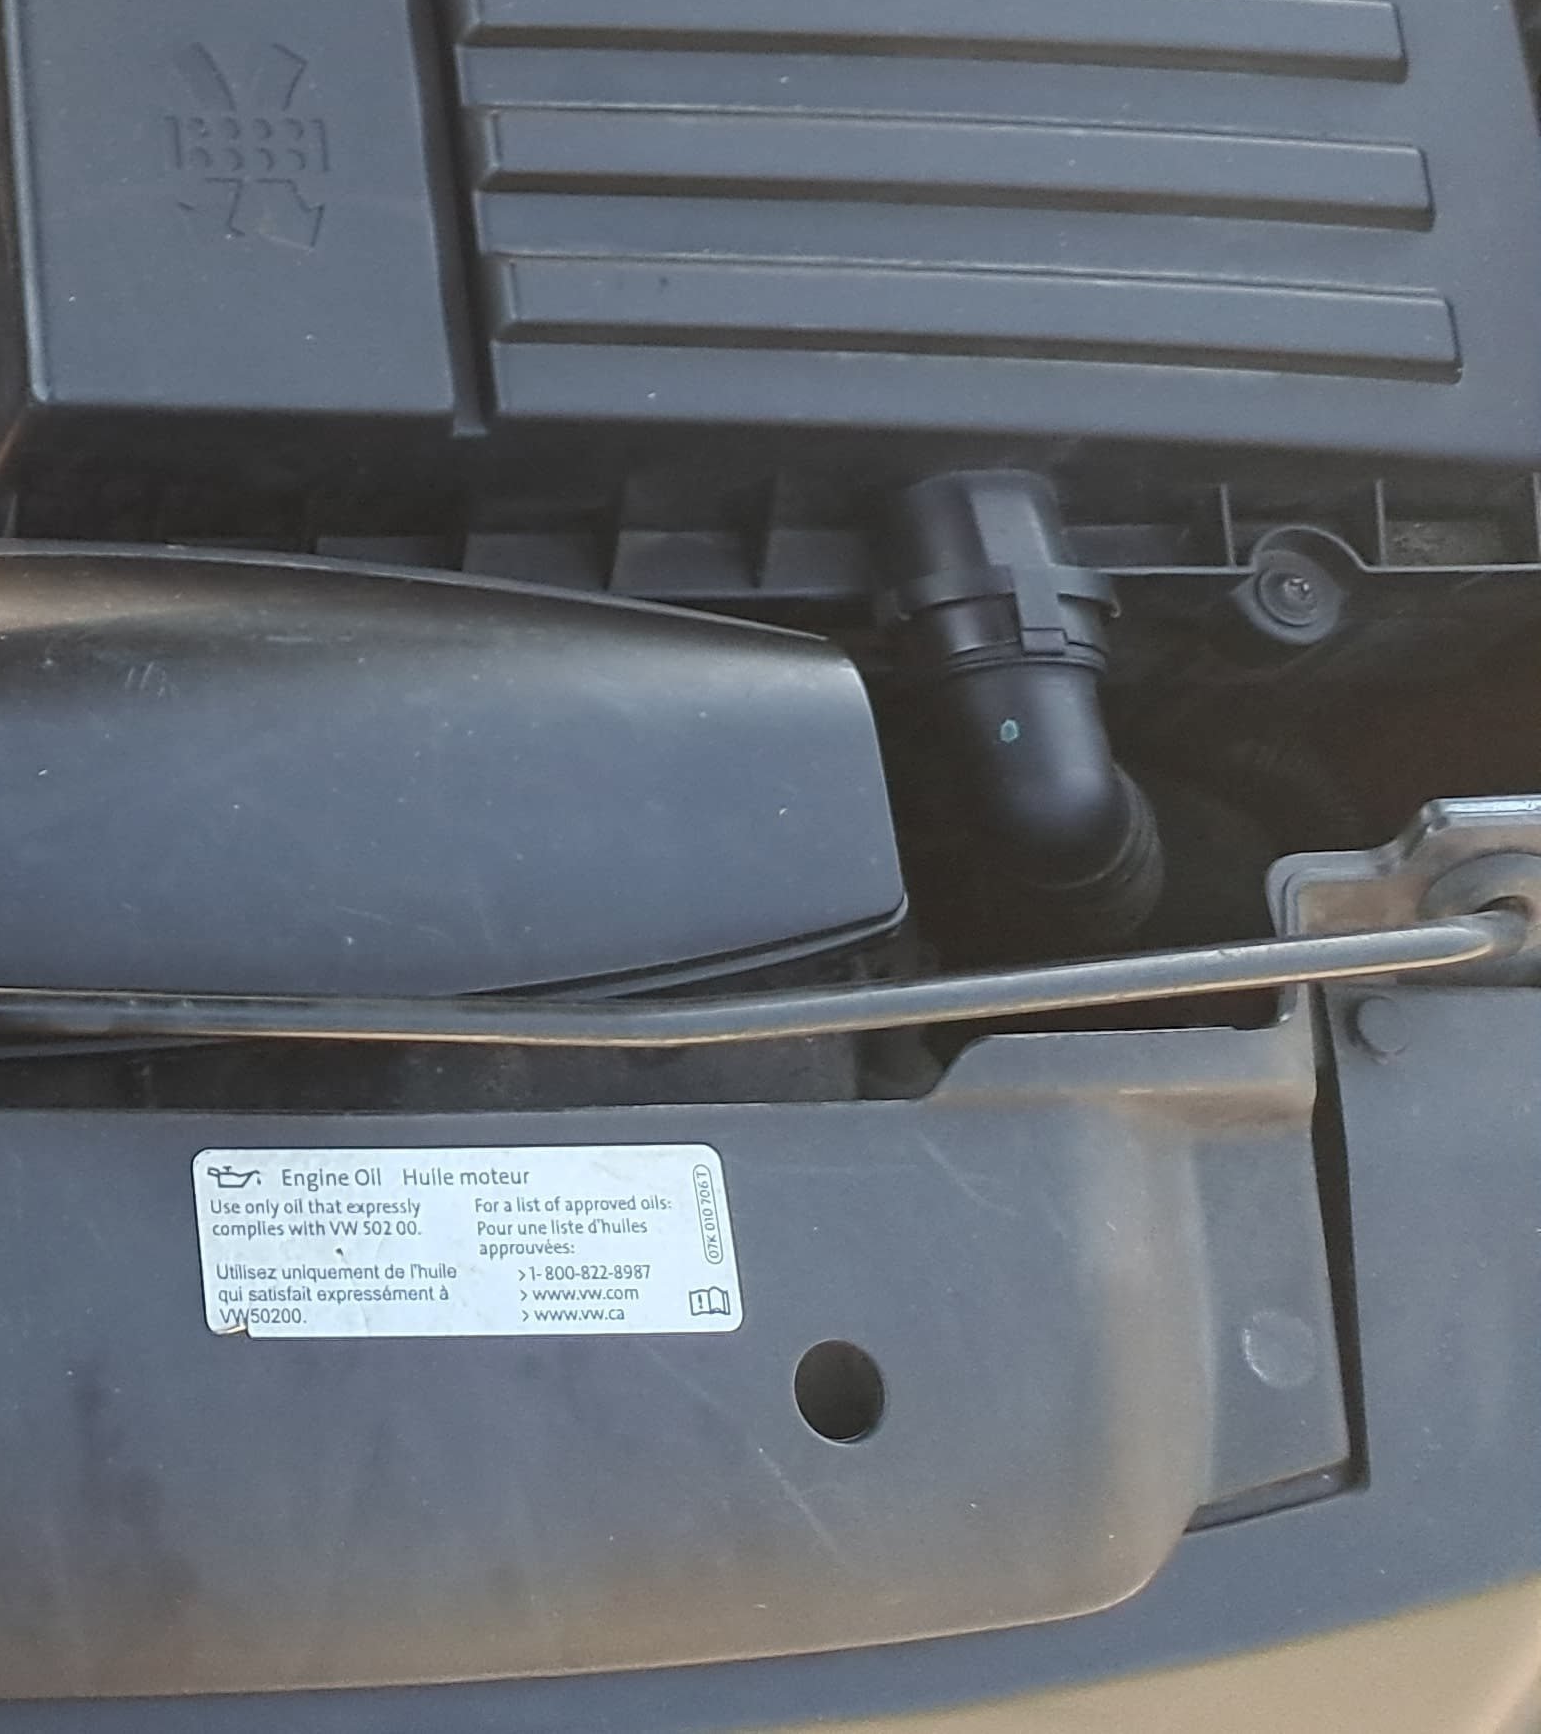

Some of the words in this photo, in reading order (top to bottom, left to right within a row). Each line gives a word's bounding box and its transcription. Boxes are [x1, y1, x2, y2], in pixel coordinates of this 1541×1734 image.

[282, 1169, 349, 1192] Engine
[354, 1168, 382, 1186] Oil
[402, 1168, 454, 1186] Huile
[460, 1168, 530, 1186] moteur
[696, 1170, 708, 1179] T
[699, 1180, 711, 1205] 706
[210, 1199, 241, 1214] Use
[245, 1199, 279, 1218] only
[284, 1199, 304, 1214] oil
[308, 1199, 342, 1214] that
[346, 1198, 421, 1218] expressly
[475, 1198, 499, 1213] For
[504, 1202, 513, 1212] a
[516, 1197, 540, 1212] list
[544, 1196, 562, 1212] of
[566, 1196, 637, 1215] approved
[640, 1195, 672, 1210] oils:
[477, 1221, 513, 1236] Pour
[517, 1223, 547, 1234] une
[550, 1219, 584, 1234] liste
[588, 1217, 648, 1234] d'huiles
[702, 1207, 715, 1231] 010
[212, 1220, 284, 1240] complies
[289, 1220, 326, 1236] with
[329, 1221, 358, 1235] VW
[363, 1221, 392, 1236] 502
[395, 1220, 422, 1236] 00.
[479, 1239, 576, 1260] approuvées:
[217, 1263, 276, 1279] Utilisez
[282, 1263, 380, 1282] uniquement
[384, 1264, 405, 1279] de
[410, 1263, 457, 1279] l'huile
[218, 1288, 243, 1308] qui
[248, 1286, 313, 1302] satisfait
[317, 1285, 435, 1304] expressément
[439, 1285, 449, 1301] à
[533, 1287, 639, 1301] www.vw.com
[534, 1307, 625, 1321] www.vw.ca
